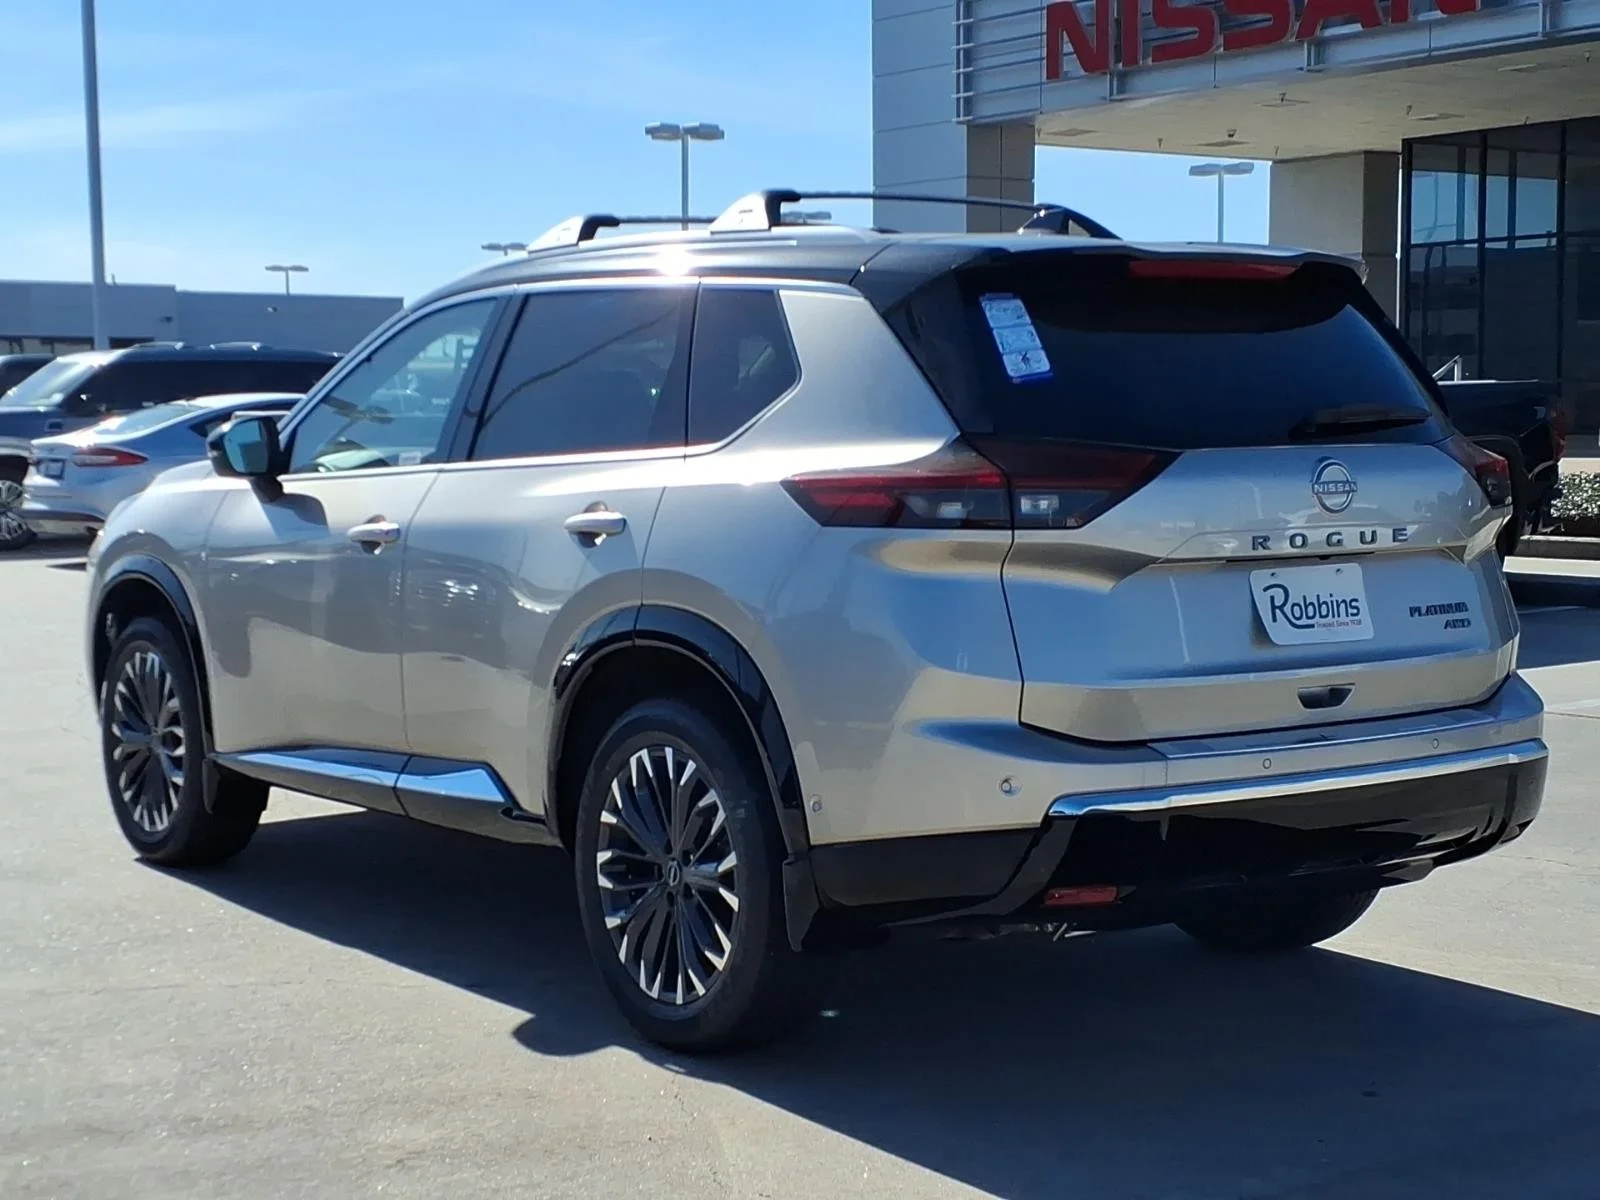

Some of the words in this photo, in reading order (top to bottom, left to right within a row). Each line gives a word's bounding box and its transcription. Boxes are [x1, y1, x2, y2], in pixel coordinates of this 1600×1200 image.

[1046, 0, 1481, 79] NISS
[1312, 482, 1357, 493] NISSAN
[1252, 527, 1409, 550] ROGUE
[1262, 583, 1361, 629] Robbins
